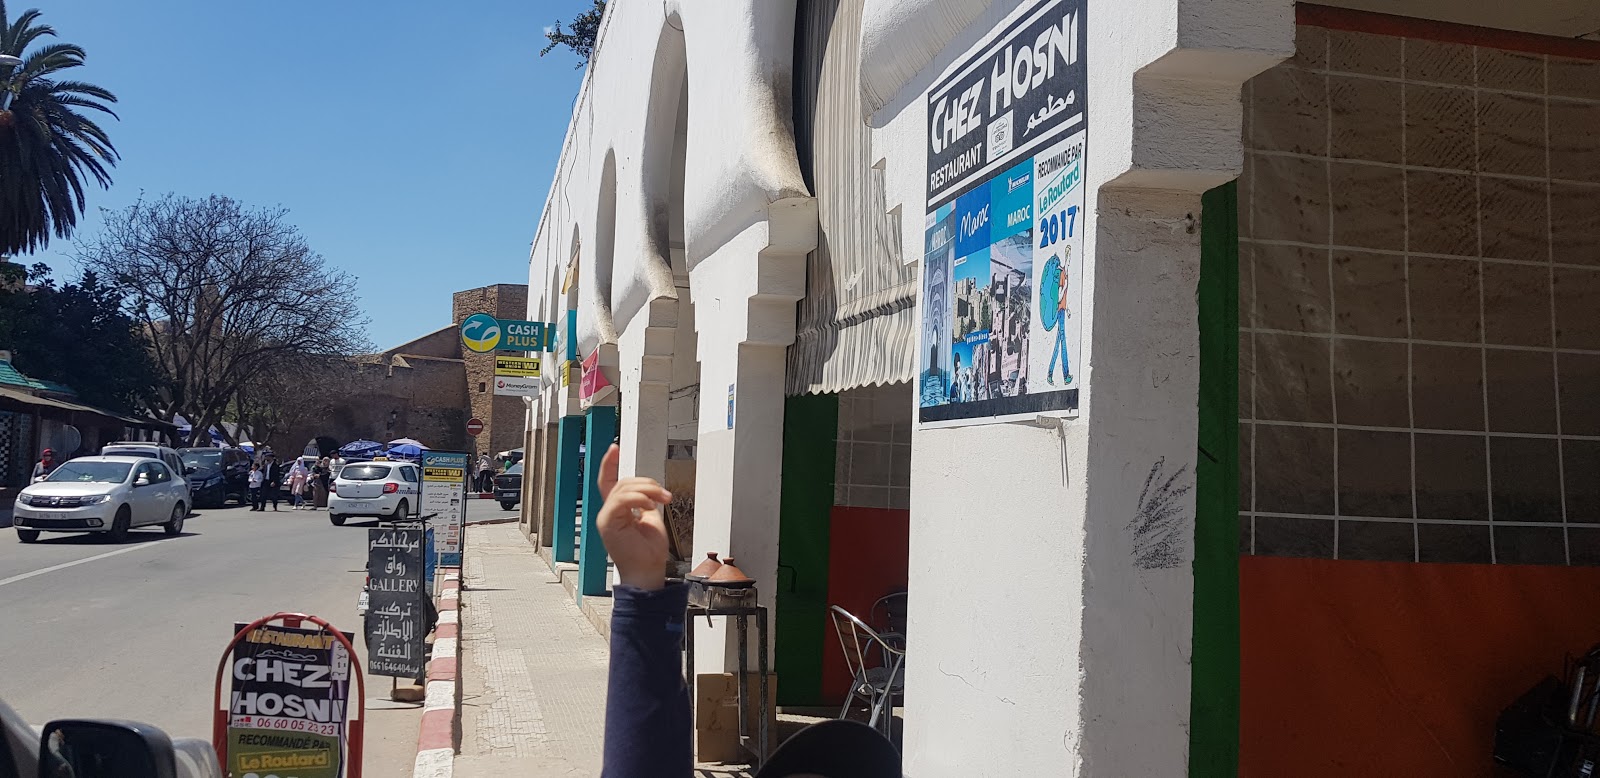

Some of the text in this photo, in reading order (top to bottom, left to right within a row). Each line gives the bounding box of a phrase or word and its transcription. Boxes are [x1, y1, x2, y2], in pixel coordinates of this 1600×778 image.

[931, 8, 1078, 154] CHEZ HOSNI
[1023, 89, 1076, 137] مطعم
[930, 142, 983, 193] RESTAURANT
[1037, 142, 1082, 179] RECOMMANDÉ PAR
[1039, 161, 1080, 215] Le Routard
[960, 203, 990, 243] Maroc
[1007, 204, 1031, 229] MAROC
[1040, 205, 1077, 249] 2017
[507, 324, 539, 336] CASH
[507, 336, 538, 347] PLUS
[385, 554, 406, 577] رواق
[370, 578, 420, 593] GALLERY
[374, 601, 412, 621] تركيب
[377, 642, 411, 662] الفنية
[233, 657, 333, 688] CHEZ
[231, 691, 344, 723] HOSNI
[257, 718, 271, 728] 06
[274, 719, 288, 729] 60
[291, 720, 305, 730] 05
[320, 725, 335, 735] 23
[238, 734, 312, 749] RECOMMANDÉ
[240, 751, 328, 770] Le Routard
